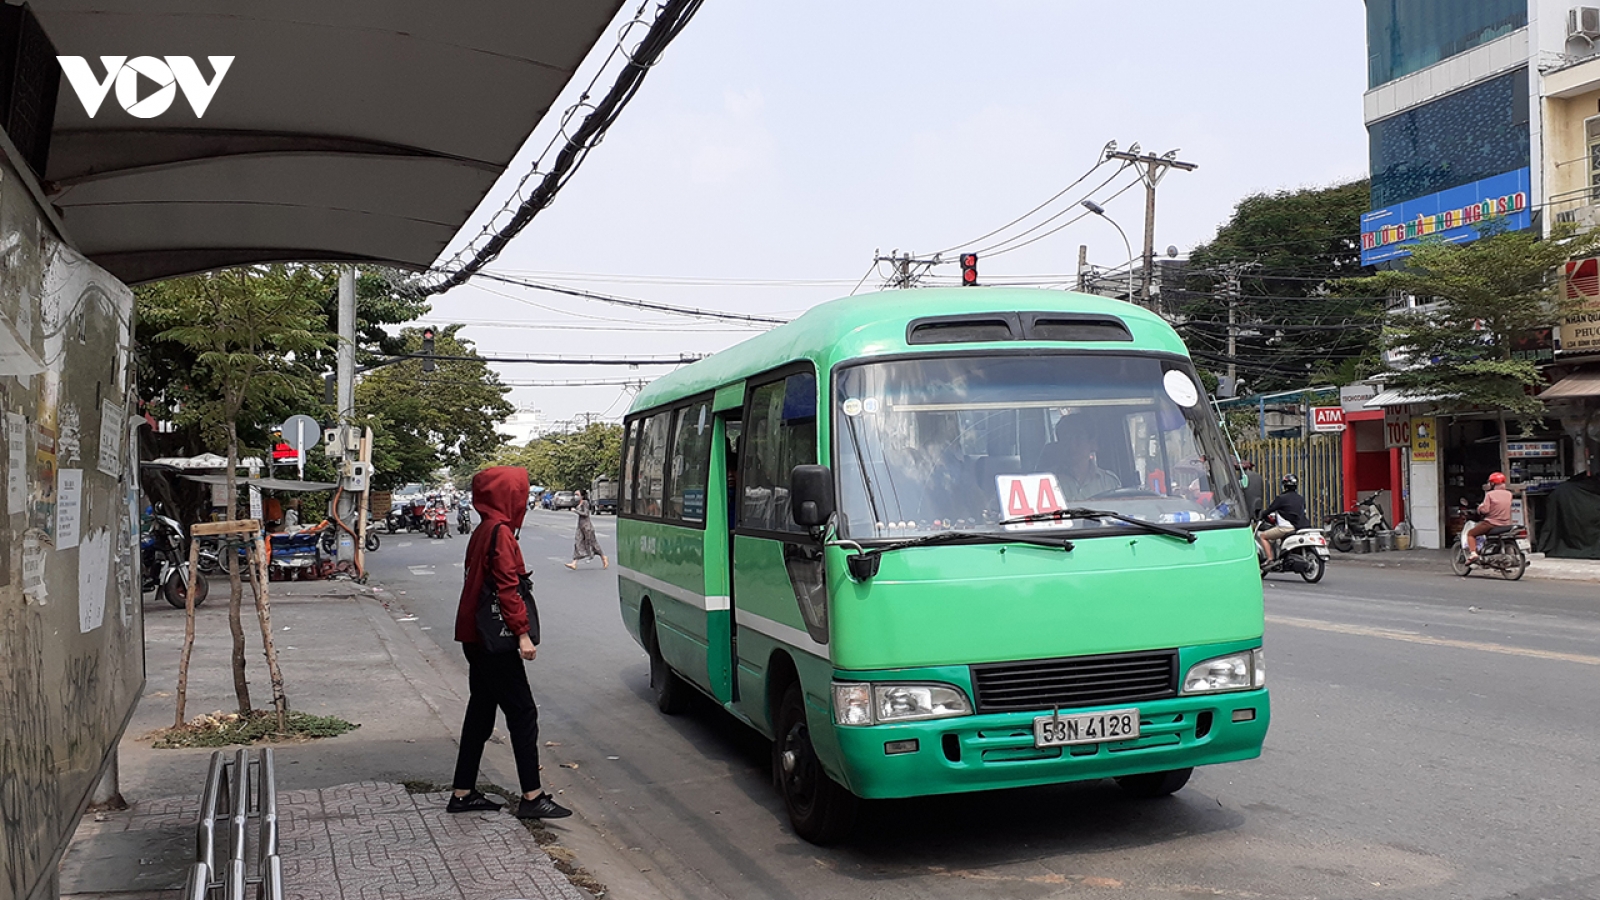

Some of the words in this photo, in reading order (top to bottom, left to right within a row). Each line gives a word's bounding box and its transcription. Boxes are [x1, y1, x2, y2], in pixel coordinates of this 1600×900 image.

[1361, 224, 1406, 250] TRƯỜNG
[1436, 208, 1463, 231] NON
[1498, 191, 1526, 215] SAO
[1317, 410, 1342, 422] ATM
[1387, 416, 1409, 444] TÓC
[1008, 478, 1063, 526] 44
